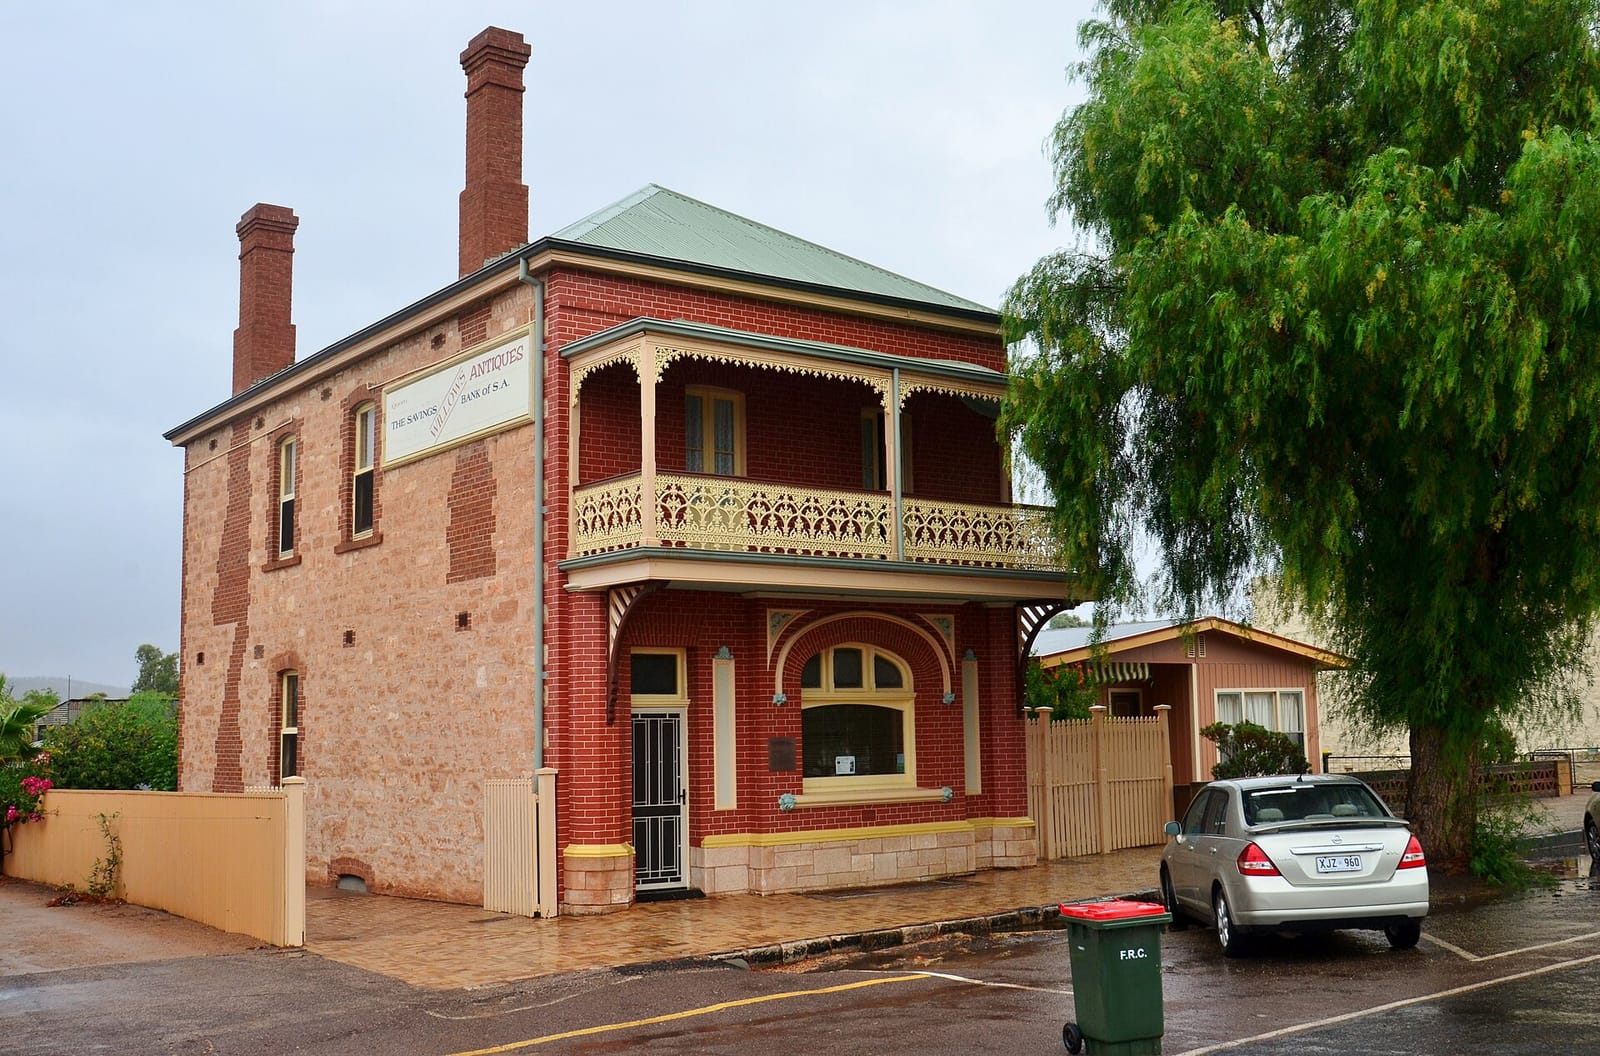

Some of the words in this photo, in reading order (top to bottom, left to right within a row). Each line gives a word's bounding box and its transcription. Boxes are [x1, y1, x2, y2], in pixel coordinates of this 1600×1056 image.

[469, 344, 524, 381] ANTIQUES
[391, 417, 407, 430] THE
[406, 404, 438, 425] SAVINGS
[460, 389, 481, 405] BANK
[481, 383, 491, 396] of
[492, 379, 510, 392] S.A.
[1319, 858, 1337, 869] XJZ
[1344, 857, 1360, 868] 960
[1119, 948, 1148, 960] F.R.C.
